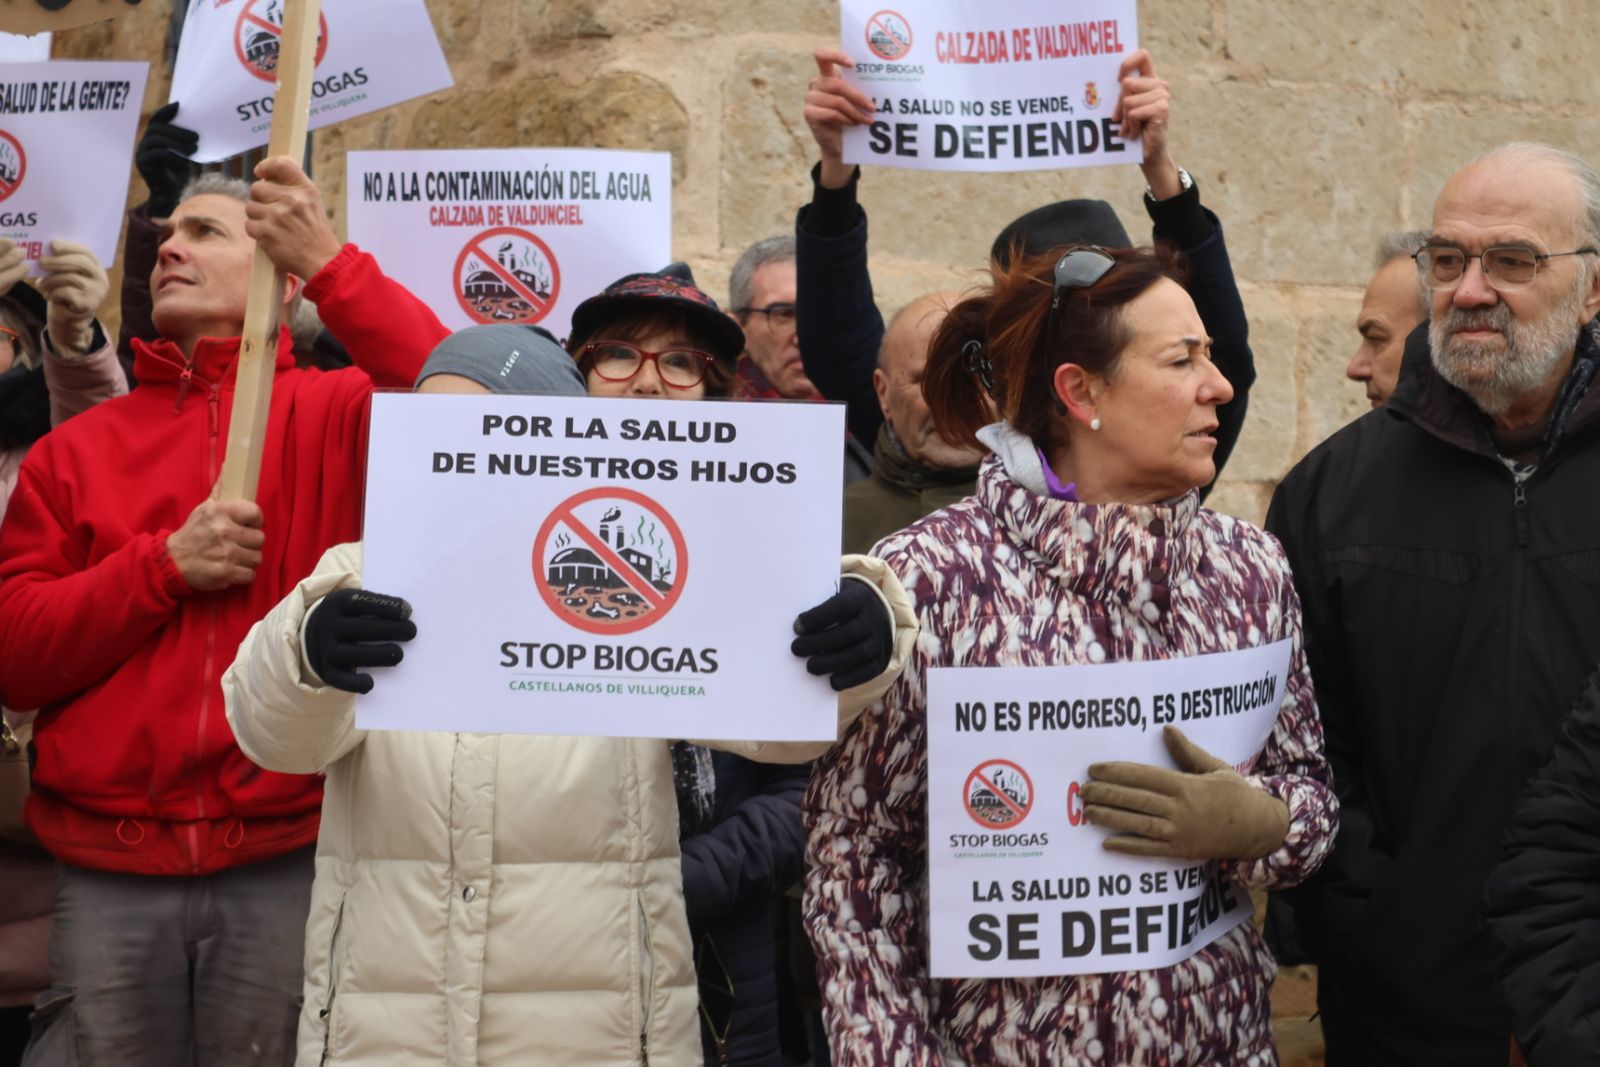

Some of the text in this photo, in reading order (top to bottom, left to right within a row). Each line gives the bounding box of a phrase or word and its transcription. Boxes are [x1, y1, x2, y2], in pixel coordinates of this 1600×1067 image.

[935, 20, 1124, 64] CALZADA DE VALDUNCIEL
[855, 63, 925, 75] STOP BIOGAS
[40, 81, 58, 112] DE
[59, 81, 76, 111] LA
[79, 80, 130, 111] GENTE?
[236, 67, 368, 121] STO OGAS
[872, 96, 1074, 116] LA SALUD NO SE VENDE,
[868, 117, 1126, 159] SE DEFIENDE
[364, 163, 652, 202] NO A LA CONTAMINACIÓN DEL AGUA
[430, 205, 583, 226] CALZADA DE VALDUNCIEL
[482, 414, 737, 444] POR LA SALUD
[432, 452, 798, 485] DE NUESTROS HIJOS
[499, 641, 719, 674] STOP BIOGAS
[508, 680, 706, 698] CASTELLANOS DE VILLIQUERA
[955, 671, 1276, 732] NO ES PROGRESO, ES DESTRUCCIÓN
[949, 832, 1049, 848] STOP BIOGAS
[972, 881, 1003, 902] LA
[1011, 878, 1091, 901] SALUD
[1098, 874, 1132, 896] NO
[1139, 872, 1168, 893] SE
[967, 913, 1039, 961] SE
